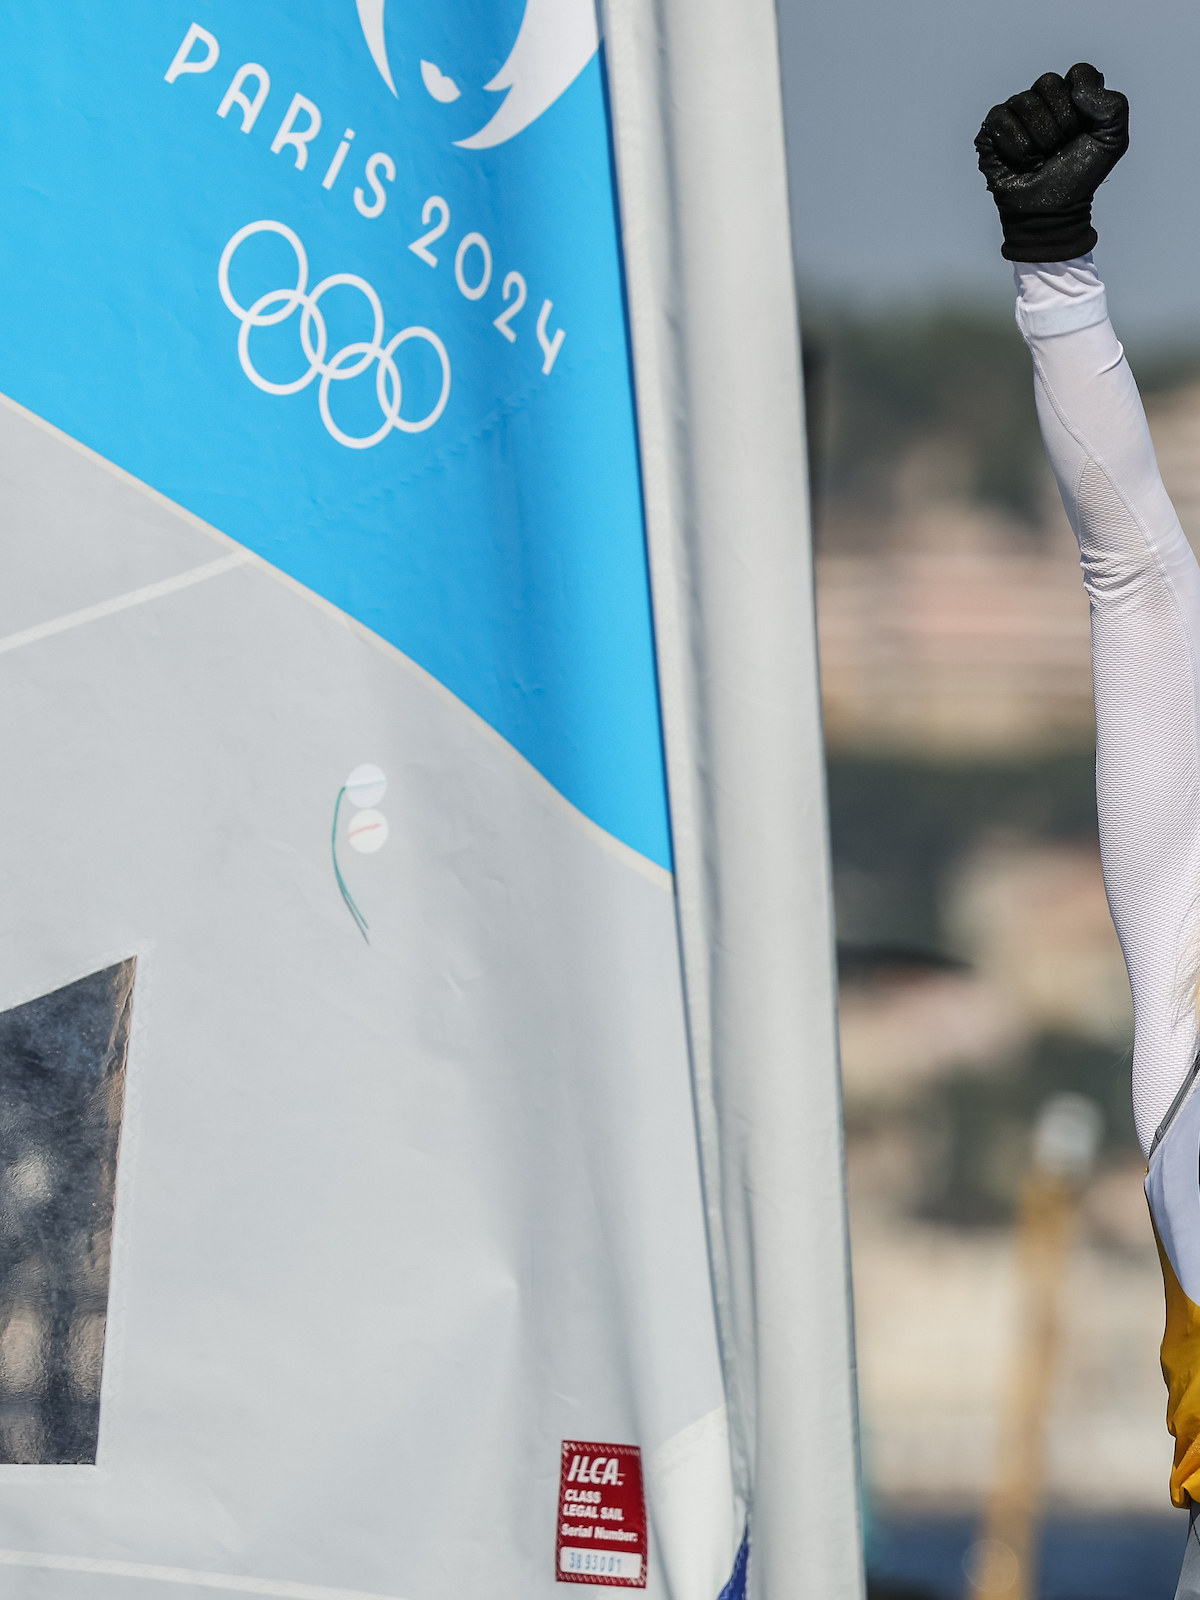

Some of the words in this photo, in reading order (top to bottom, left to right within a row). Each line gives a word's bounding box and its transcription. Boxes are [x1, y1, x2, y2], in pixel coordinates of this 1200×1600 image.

[407, 195, 567, 376] 2024
[564, 1488, 602, 1504] CLASS
[562, 1503, 599, 1519] LEGAL
[600, 1506, 625, 1522] SAIL
[561, 1523, 592, 1539] Serial
[594, 1525, 639, 1543] Number:
